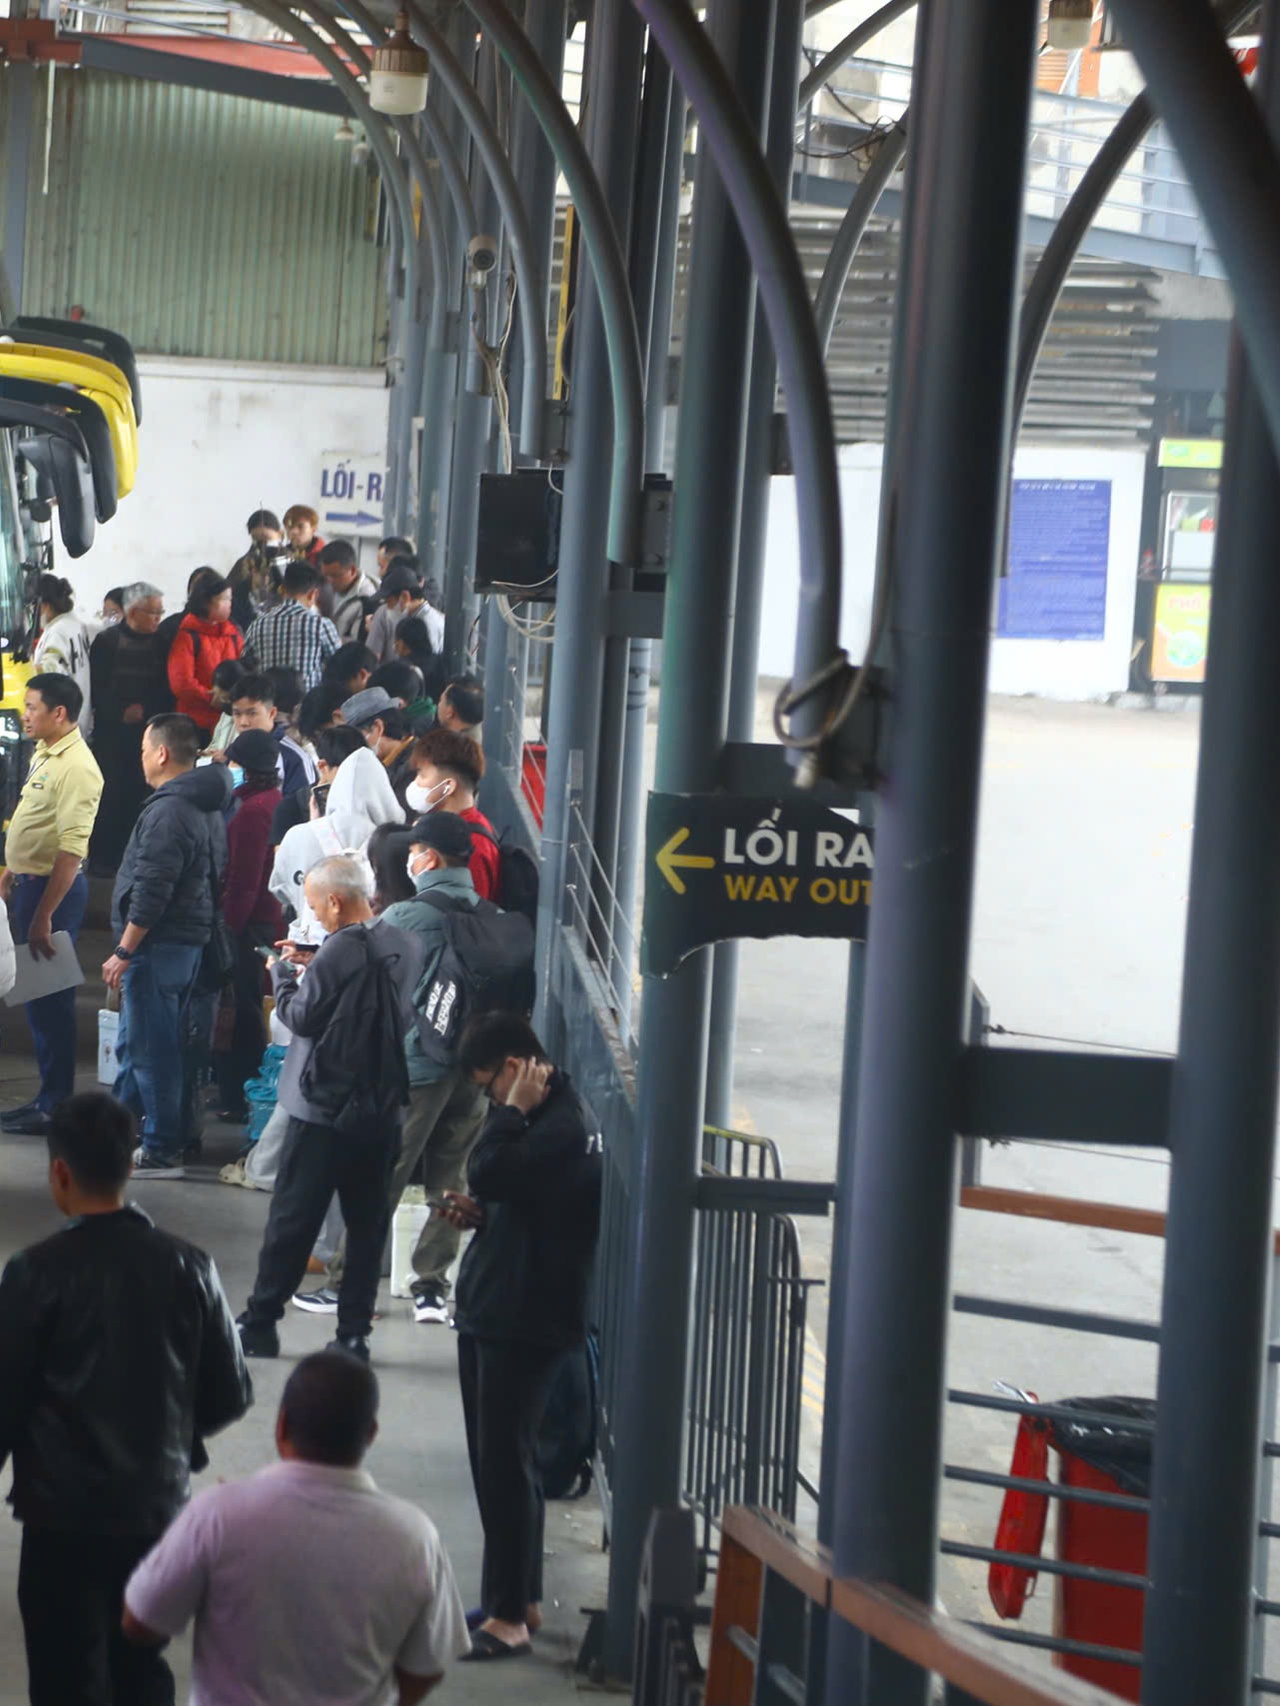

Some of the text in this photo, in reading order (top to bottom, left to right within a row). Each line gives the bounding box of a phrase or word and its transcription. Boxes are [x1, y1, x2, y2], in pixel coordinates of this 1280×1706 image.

[320, 459, 384, 502] LỐI-R
[724, 806, 875, 869] LỐI RA
[723, 873, 873, 906] WAY OUT
